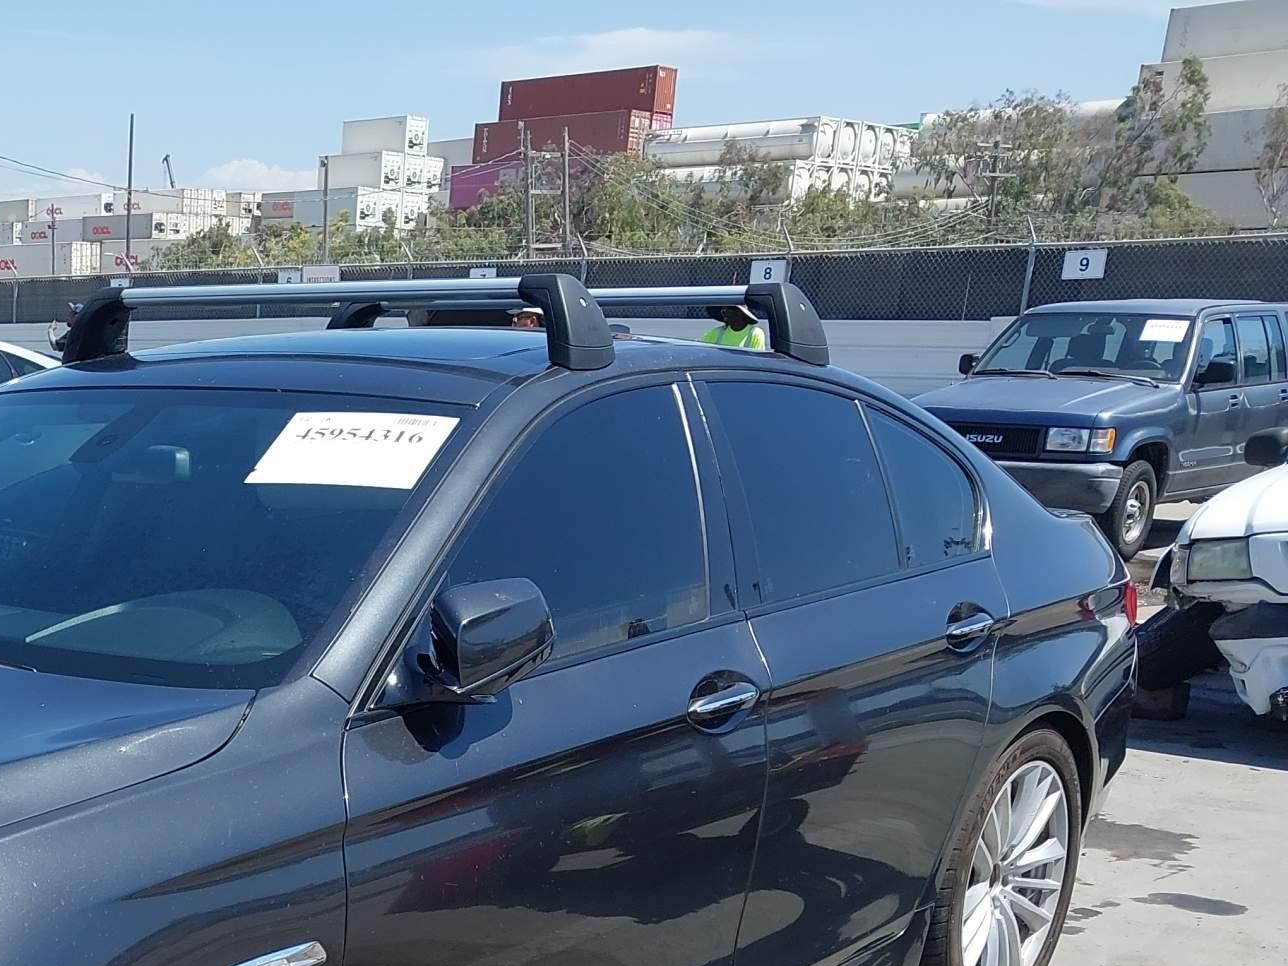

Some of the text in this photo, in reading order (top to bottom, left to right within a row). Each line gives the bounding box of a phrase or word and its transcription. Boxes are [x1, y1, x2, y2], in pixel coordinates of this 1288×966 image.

[1079, 256, 1090, 272] 9
[763, 266, 772, 280] 8
[296, 427, 424, 444] 45954316
[965, 433, 1003, 443] ISUZU
